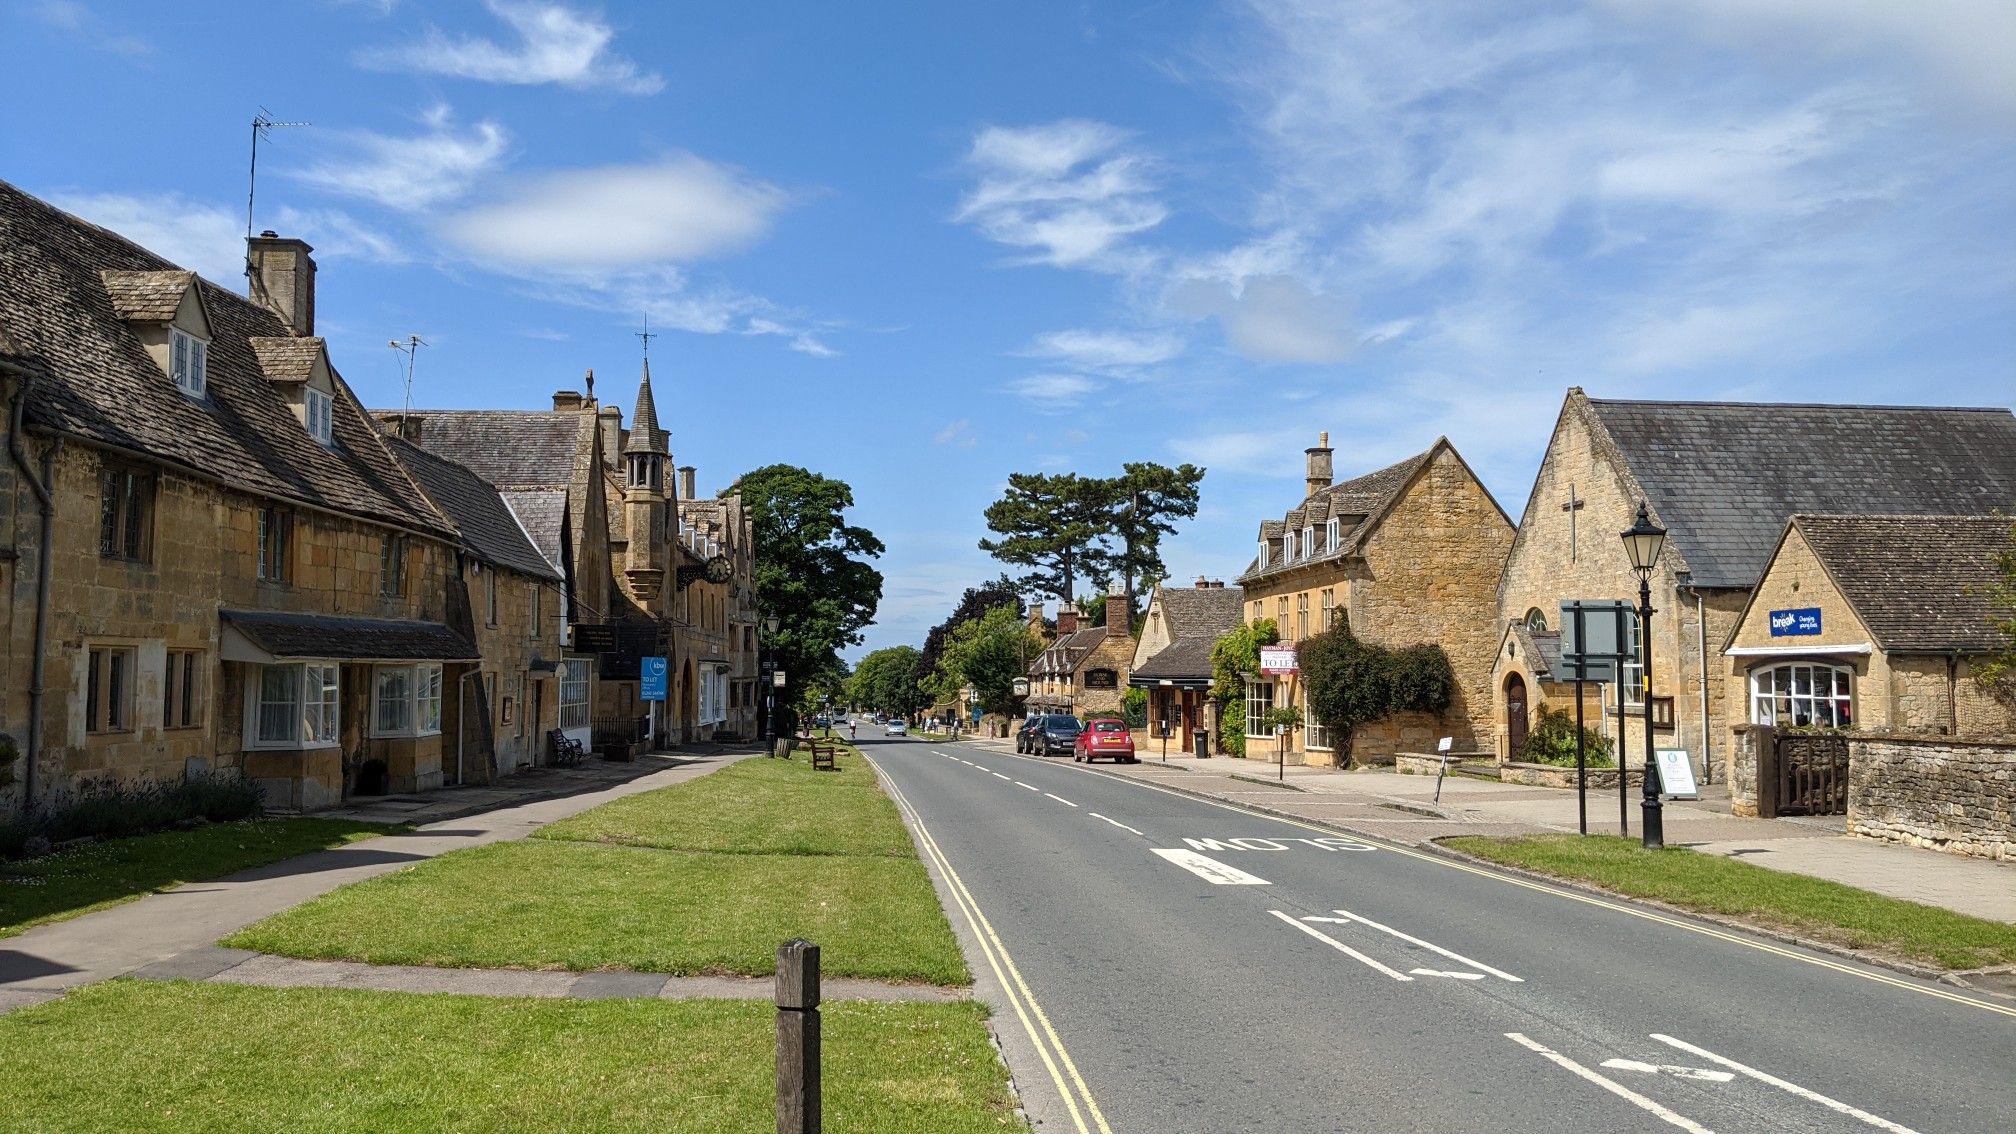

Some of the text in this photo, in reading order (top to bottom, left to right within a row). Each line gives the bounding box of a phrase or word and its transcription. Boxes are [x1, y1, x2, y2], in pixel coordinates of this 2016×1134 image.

[1772, 613, 1795, 628] break
[1263, 659, 1277, 667] TO
[1181, 838, 1378, 851] SLOW
